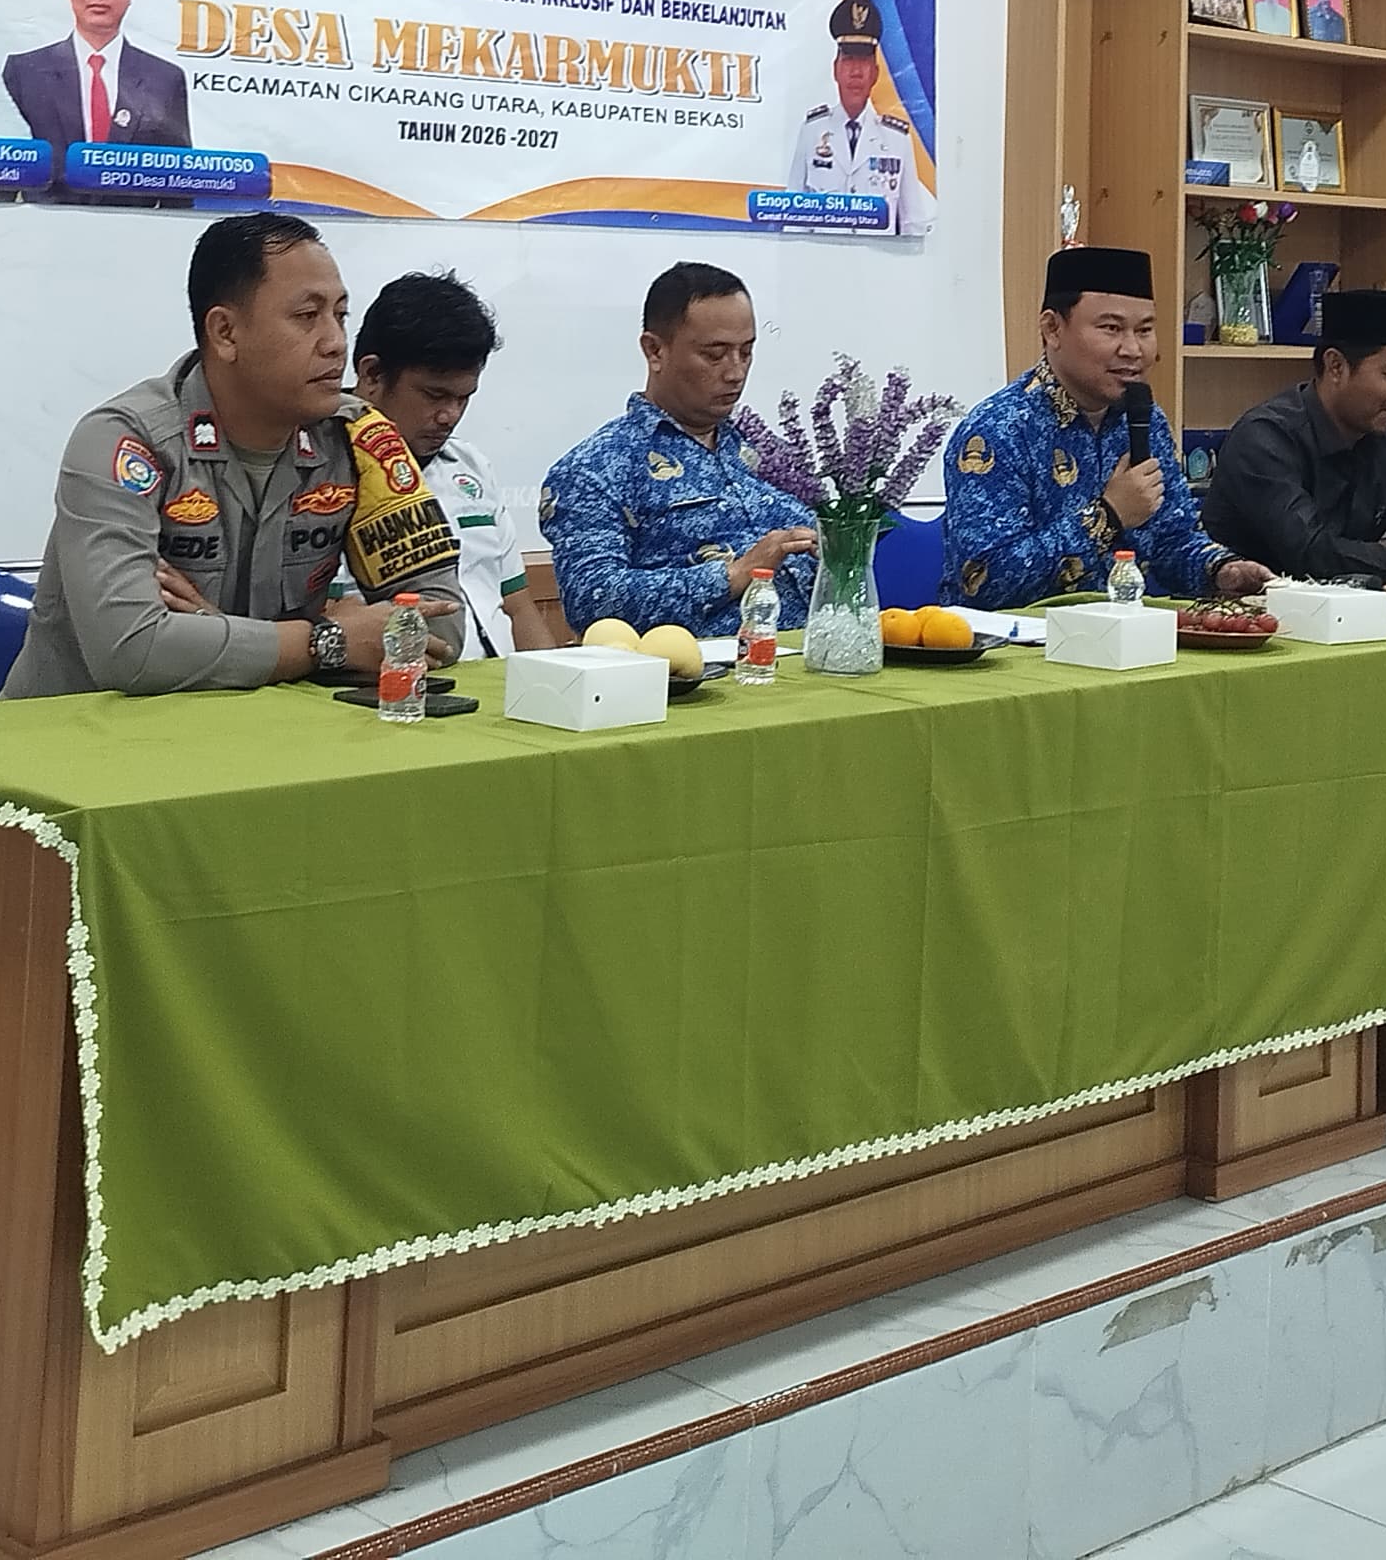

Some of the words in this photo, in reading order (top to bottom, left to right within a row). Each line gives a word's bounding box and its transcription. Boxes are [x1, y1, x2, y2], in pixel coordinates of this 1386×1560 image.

[661, 0, 786, 31] BERKELANJUTAN
[373, 17, 762, 103] MEKARMUKTI
[193, 73, 340, 101] KECAMATAN
[348, 85, 464, 109] CIKARANG
[471, 95, 544, 117] UTARA,
[551, 101, 667, 124] KABUPATEN
[674, 109, 744, 129] BEKASI
[398, 120, 455, 143] TAHUN
[461, 125, 505, 146] 2026
[510, 129, 558, 150] -2027
[81, 149, 138, 167] TEGUH
[141, 152, 180, 169] BUDI
[183, 155, 255, 173] SANTOSO
[100, 171, 131, 186] BPD
[133, 173, 165, 187] Desa
[168, 175, 236, 190] Mekarmukti
[757, 193, 791, 210] Enop
[793, 195, 822, 210] Can,
[825, 197, 848, 211] SH,
